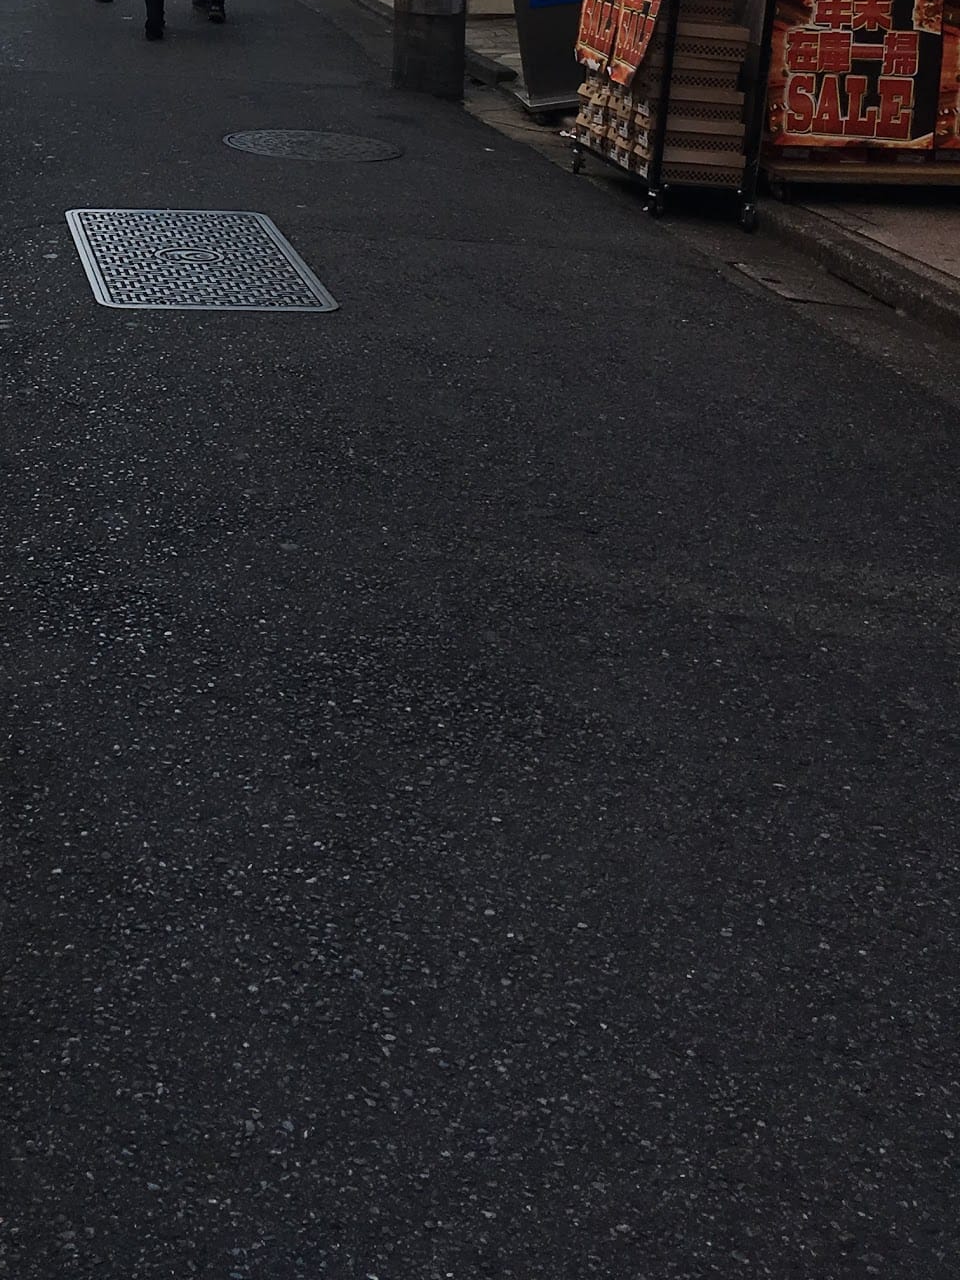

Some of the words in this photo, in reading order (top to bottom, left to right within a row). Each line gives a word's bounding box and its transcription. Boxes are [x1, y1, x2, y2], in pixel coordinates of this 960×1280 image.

[786, 29, 920, 77] 在庫一掃
[784, 73, 915, 141] SALE
